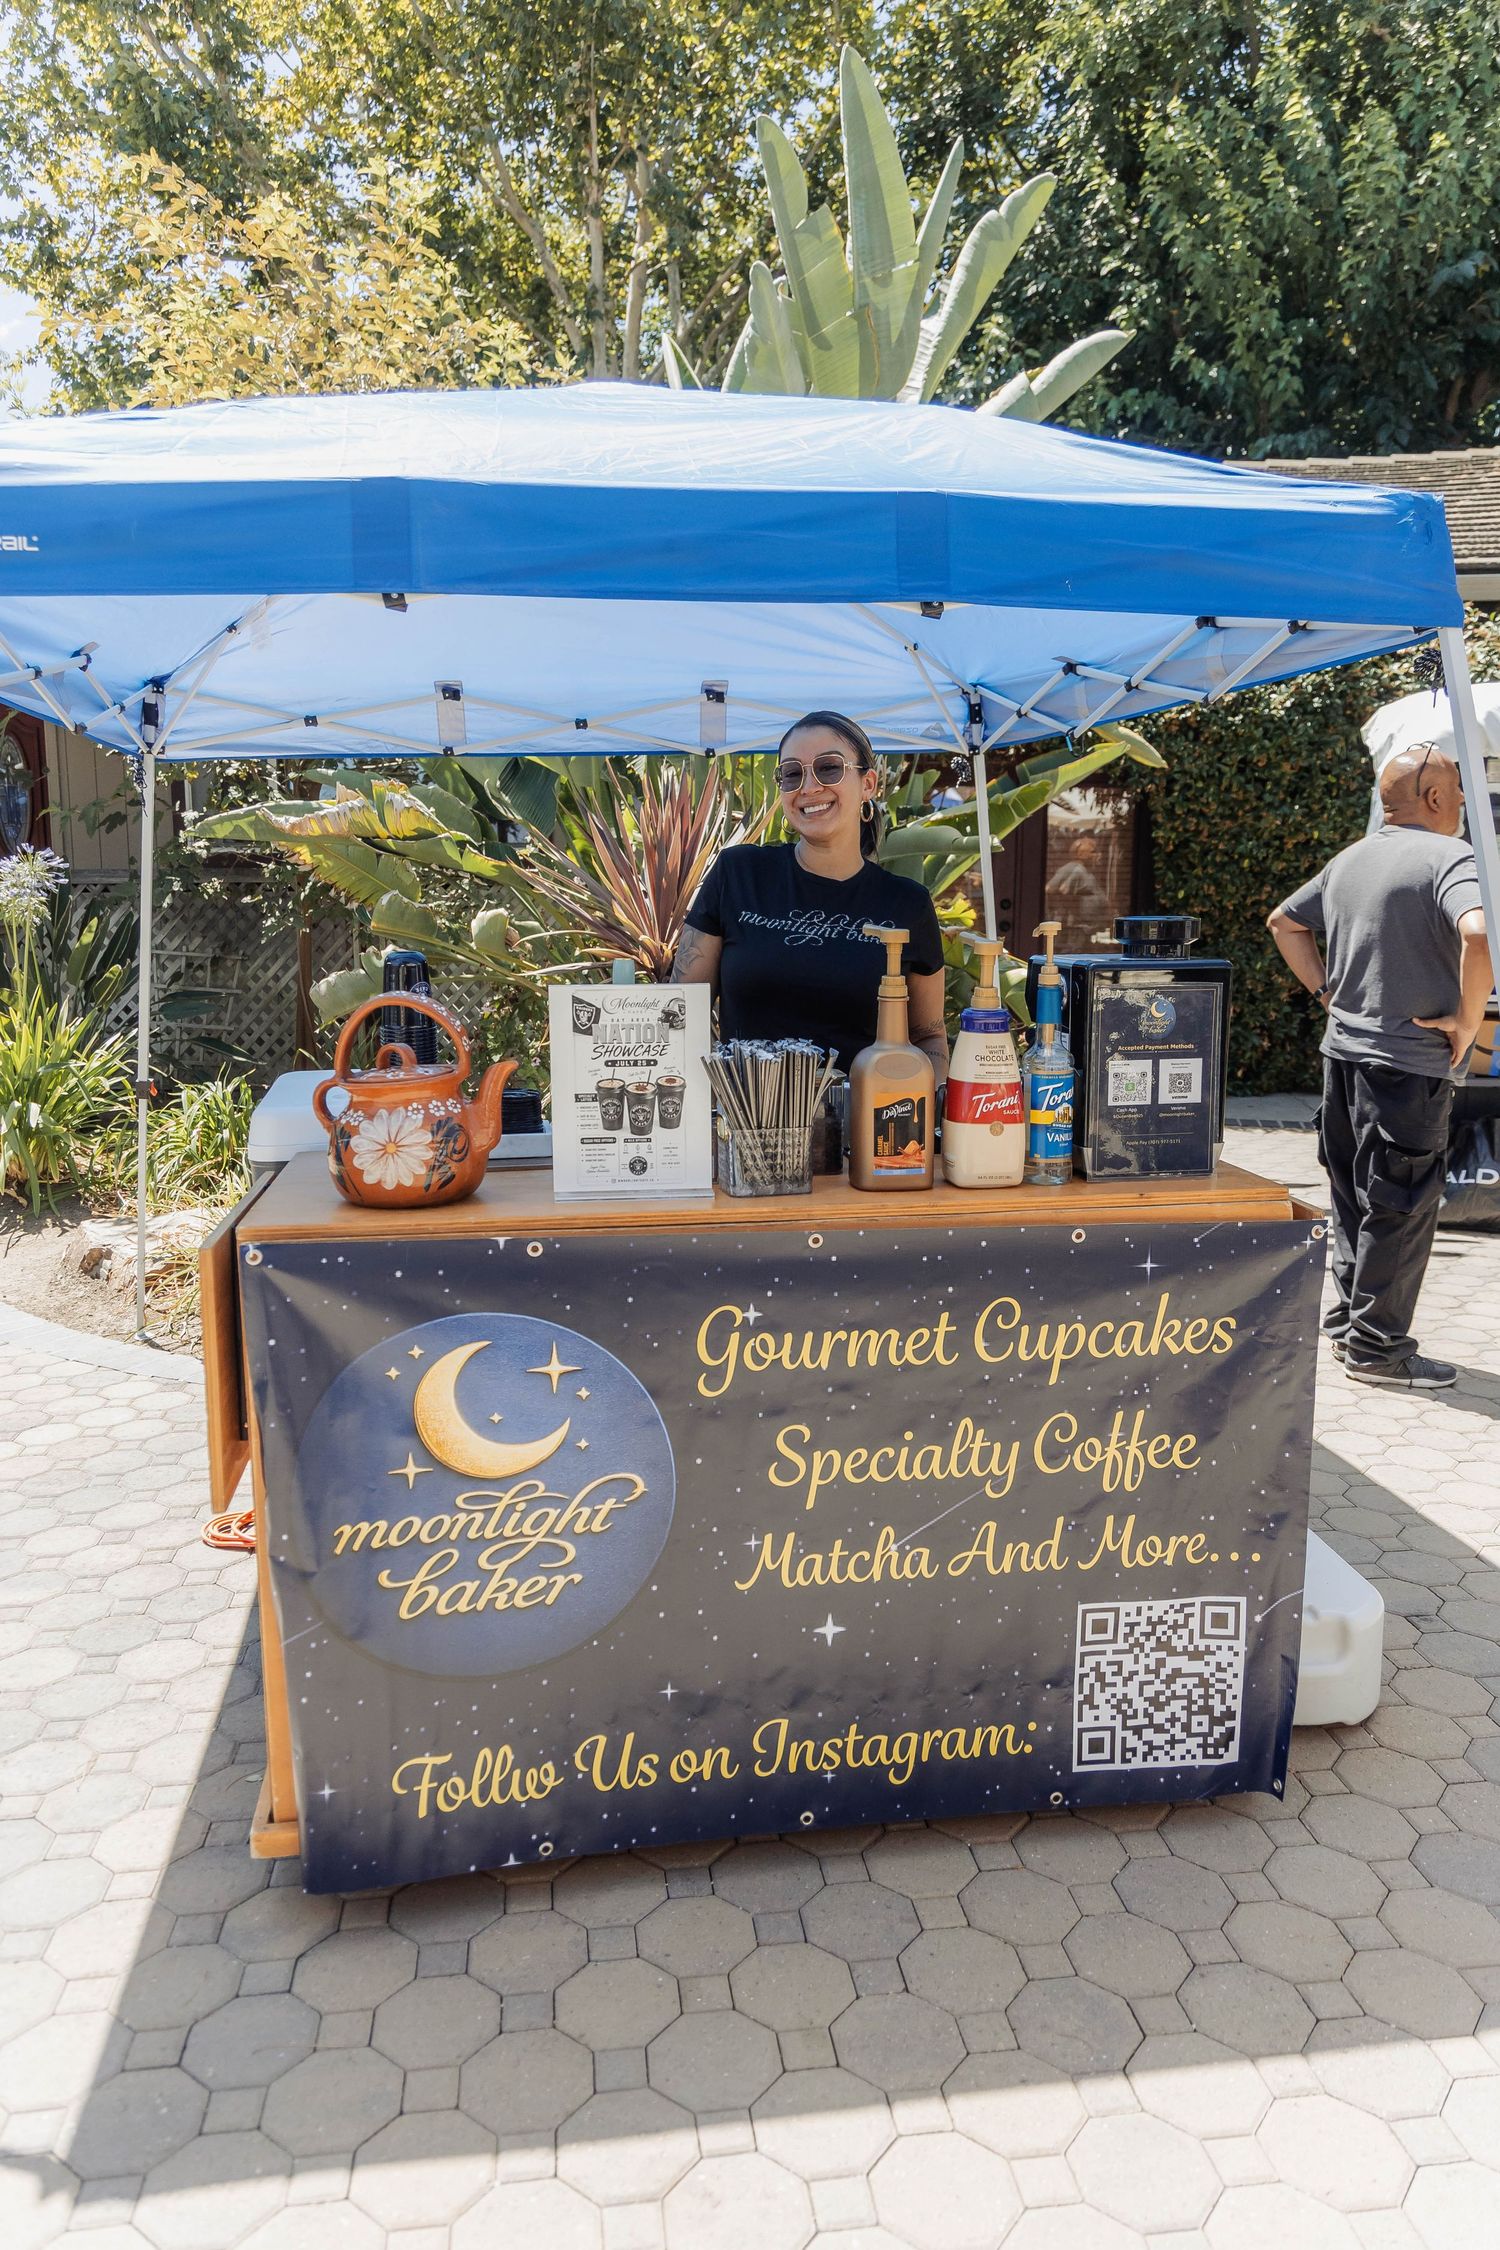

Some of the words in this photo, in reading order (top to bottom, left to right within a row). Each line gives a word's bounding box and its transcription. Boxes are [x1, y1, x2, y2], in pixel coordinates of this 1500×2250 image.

[592, 1024, 669, 1044] NATION
[602, 996, 660, 1015] Moonlight
[591, 1044, 671, 1061] SHOWCASE
[972, 1090, 1019, 1119] Torani
[1037, 1082, 1074, 1113] Tora
[696, 1304, 959, 1398] Gourmet
[973, 1292, 1237, 1386] Cupcakes
[767, 1417, 1021, 1511] Specialty
[1032, 1409, 1201, 1493] Coffee
[333, 1473, 649, 1569] moonlight
[734, 1525, 939, 1590] Matcha
[947, 1515, 1069, 1576] And
[1077, 1513, 1262, 1571] More...
[377, 1548, 584, 1620] baker
[573, 1731, 660, 1792] Us
[669, 1746, 740, 1783] on
[752, 1718, 1038, 1786] Instagram:
